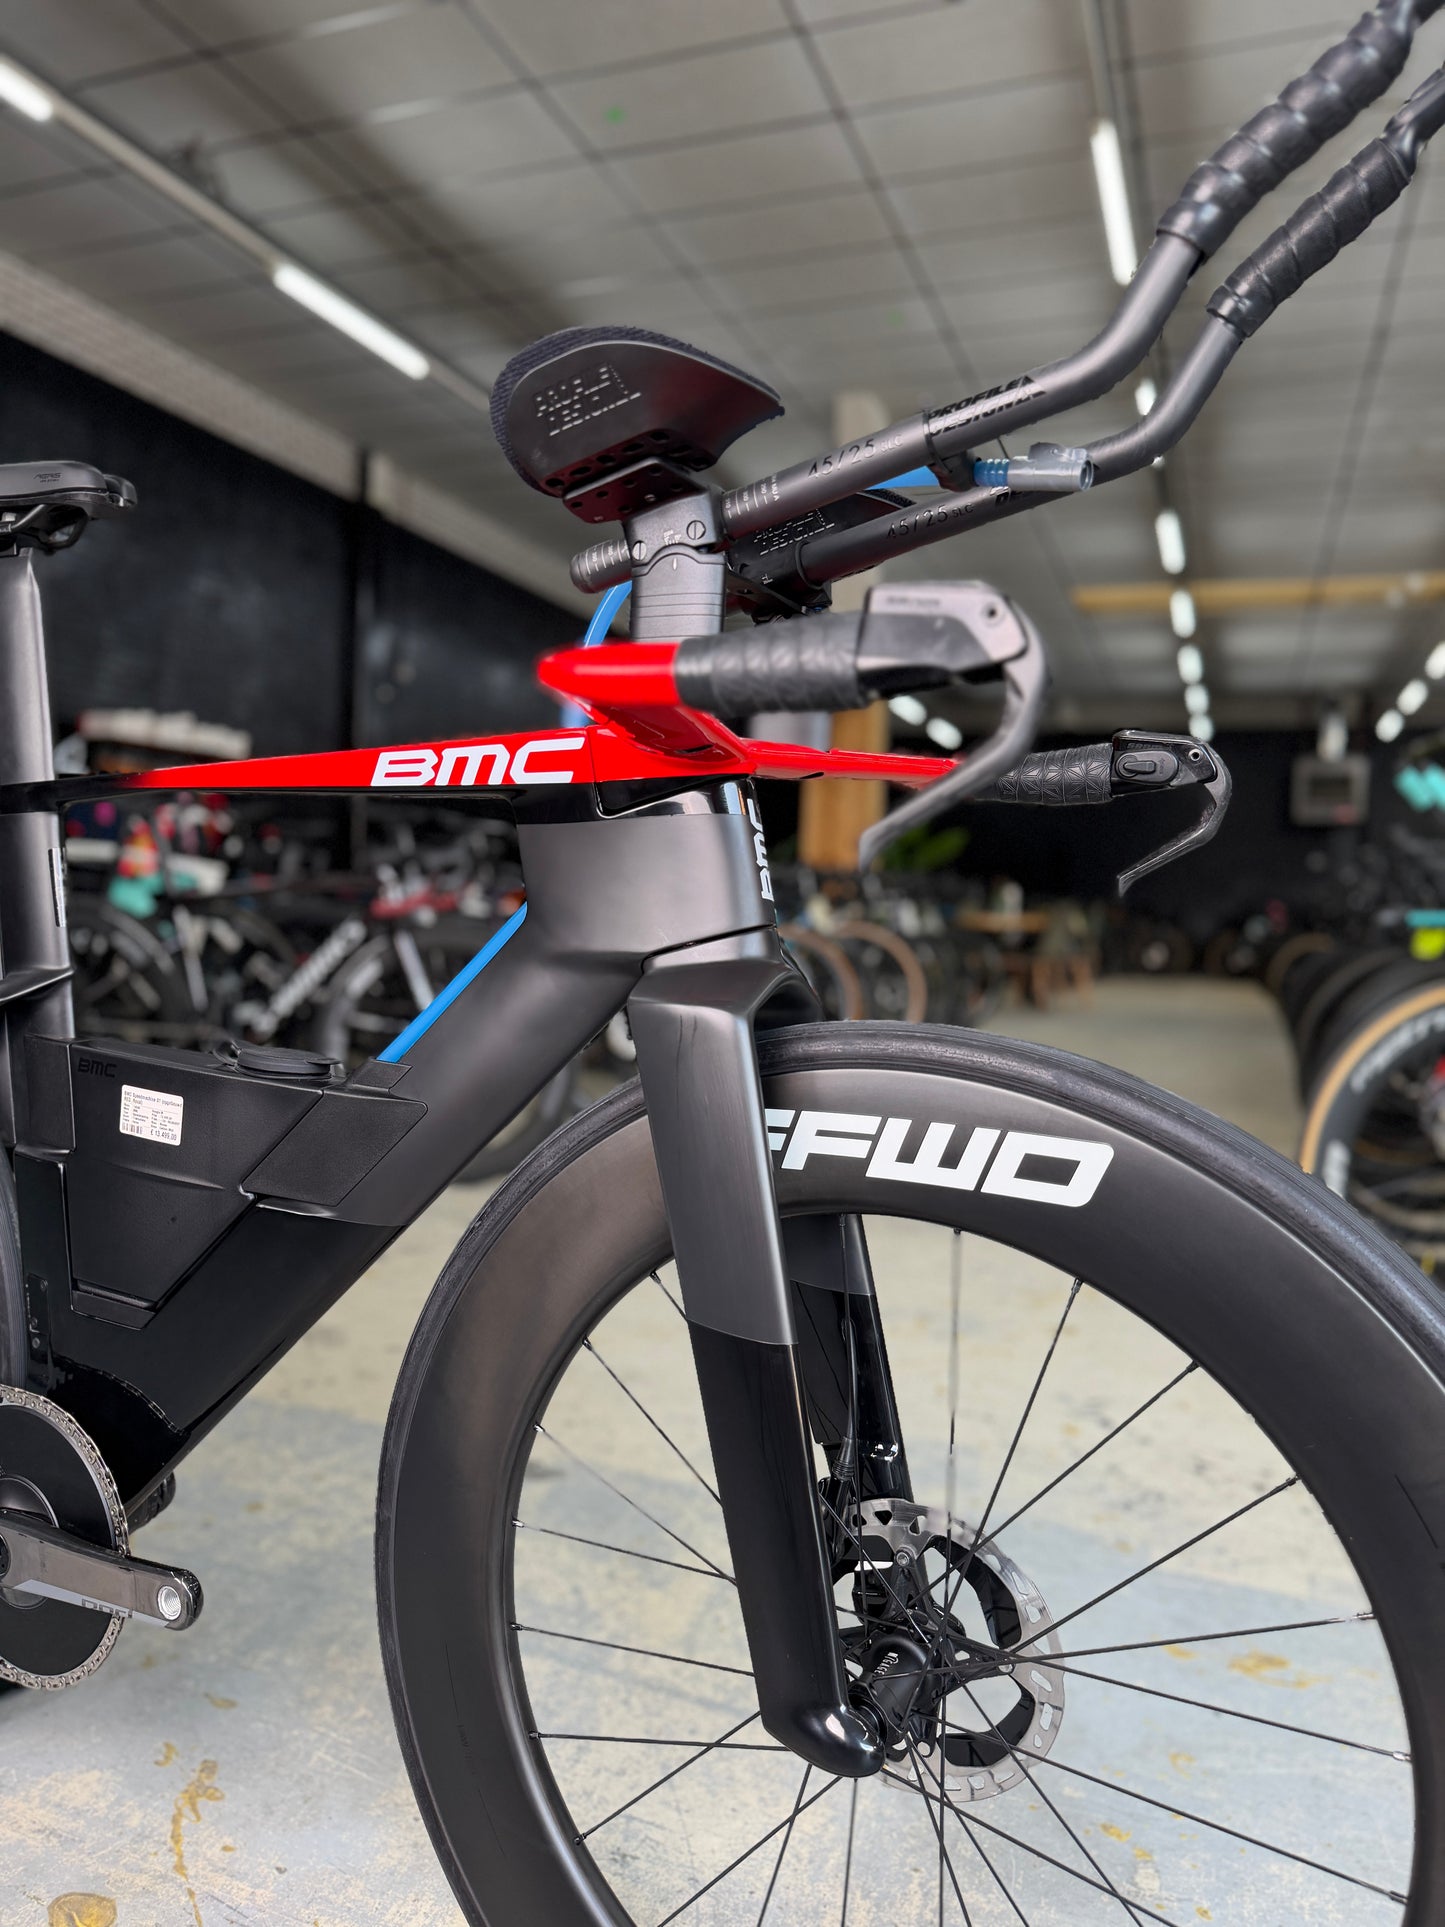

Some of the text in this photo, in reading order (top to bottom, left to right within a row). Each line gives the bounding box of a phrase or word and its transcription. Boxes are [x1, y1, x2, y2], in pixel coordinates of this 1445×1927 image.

[928, 376, 1024, 420] PROFILE
[807, 438, 876, 479] 45/25
[887, 504, 949, 538] 45/25
[370, 736, 586, 787] BMC
[746, 798, 775, 902] BMC
[77, 1057, 118, 1078] BMC
